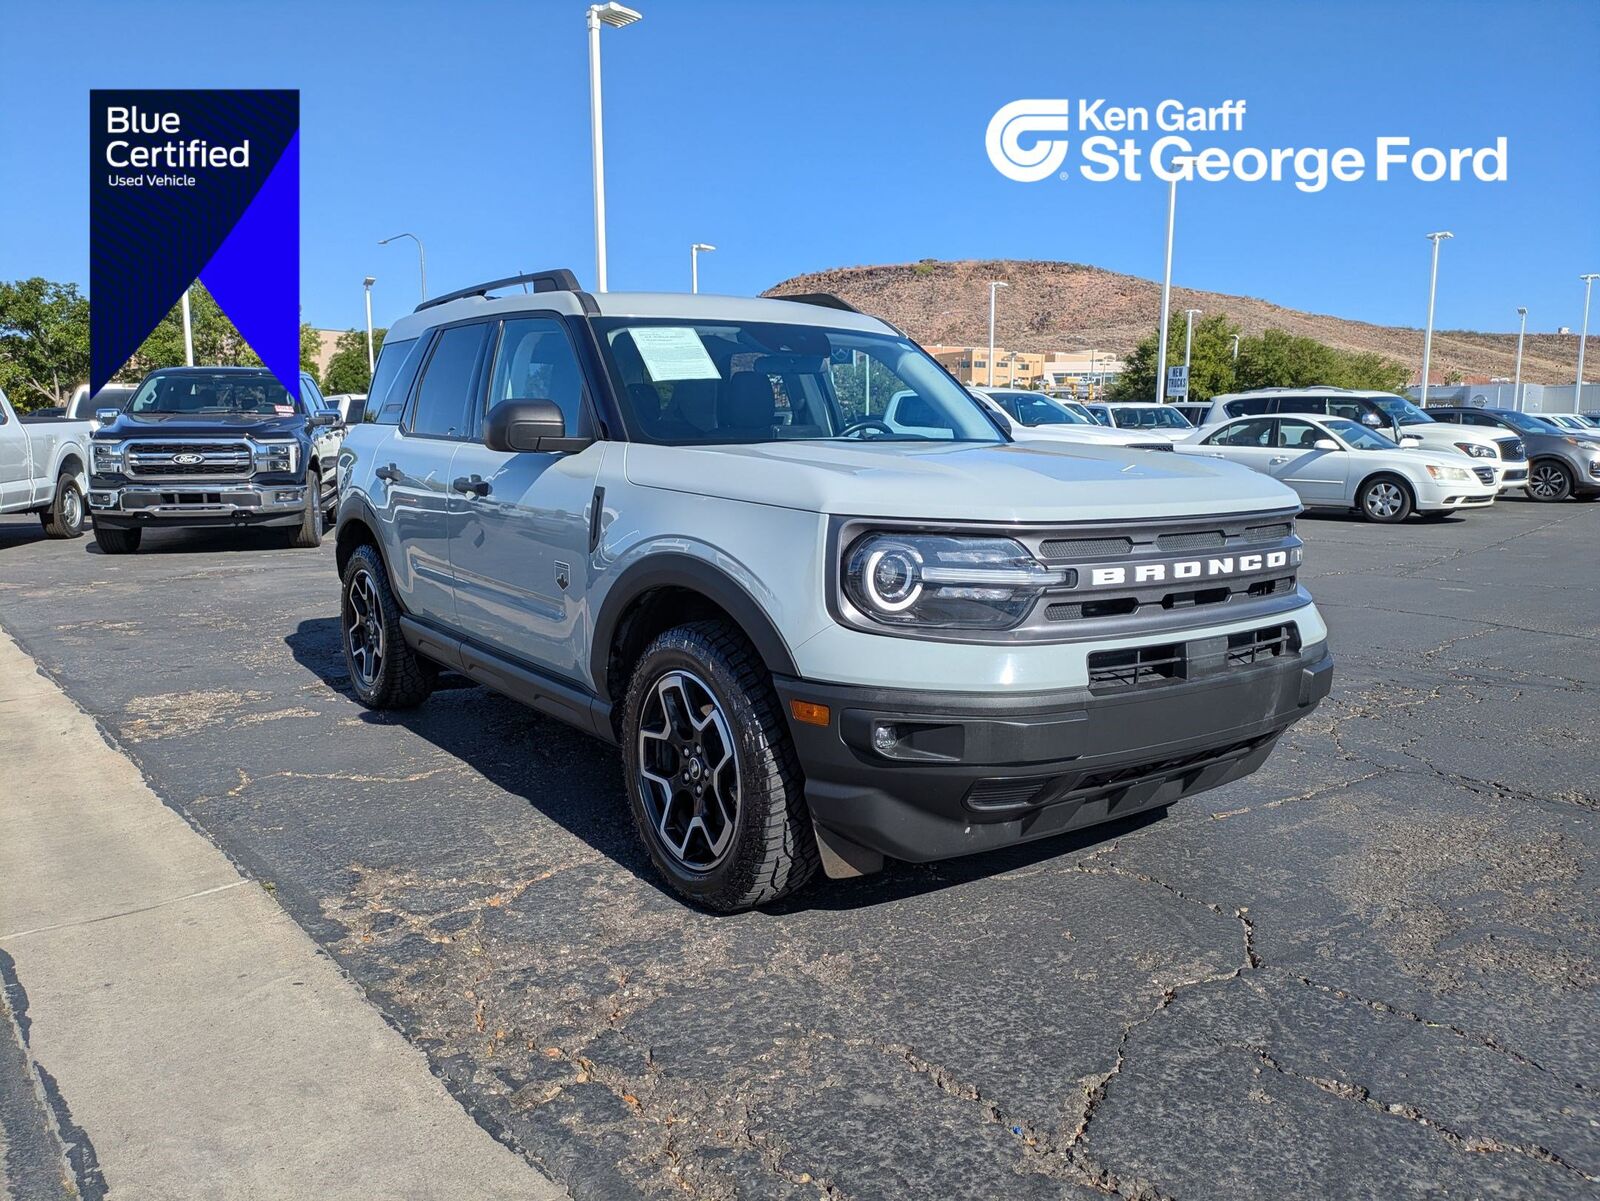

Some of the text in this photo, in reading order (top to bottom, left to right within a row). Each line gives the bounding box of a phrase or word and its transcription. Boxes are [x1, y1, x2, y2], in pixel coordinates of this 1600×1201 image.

[1172, 367, 1184, 378] NEW
[1168, 378, 1187, 388] TRUCKS
[1092, 551, 1287, 586] BRONCO
